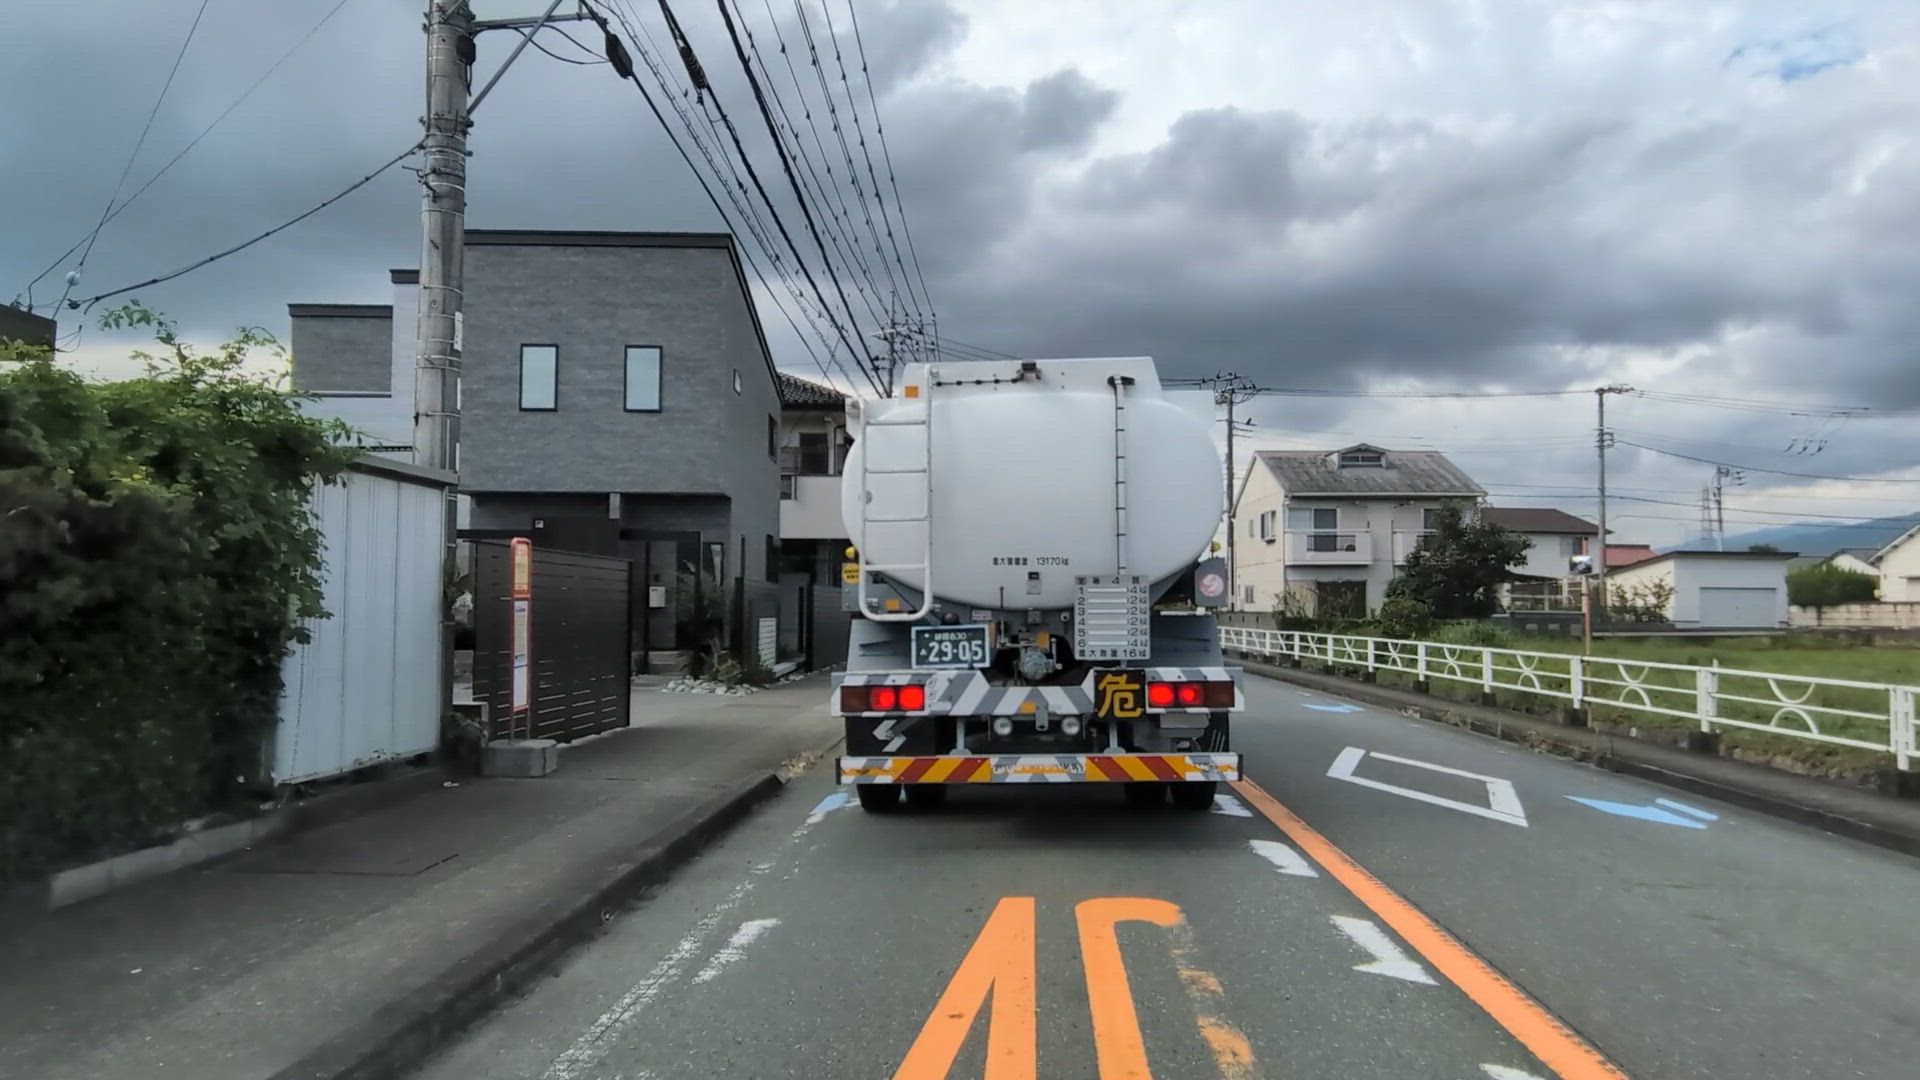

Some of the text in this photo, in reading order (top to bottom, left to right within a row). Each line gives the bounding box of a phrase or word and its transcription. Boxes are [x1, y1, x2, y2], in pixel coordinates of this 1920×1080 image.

[1079, 586, 1084, 594] 1
[1078, 597, 1085, 606] 2
[1078, 608, 1085, 616] 3
[1078, 618, 1085, 626] 4
[1078, 629, 1086, 637] 5
[1078, 639, 1086, 648] 6
[1098, 673, 1142, 718] 危
